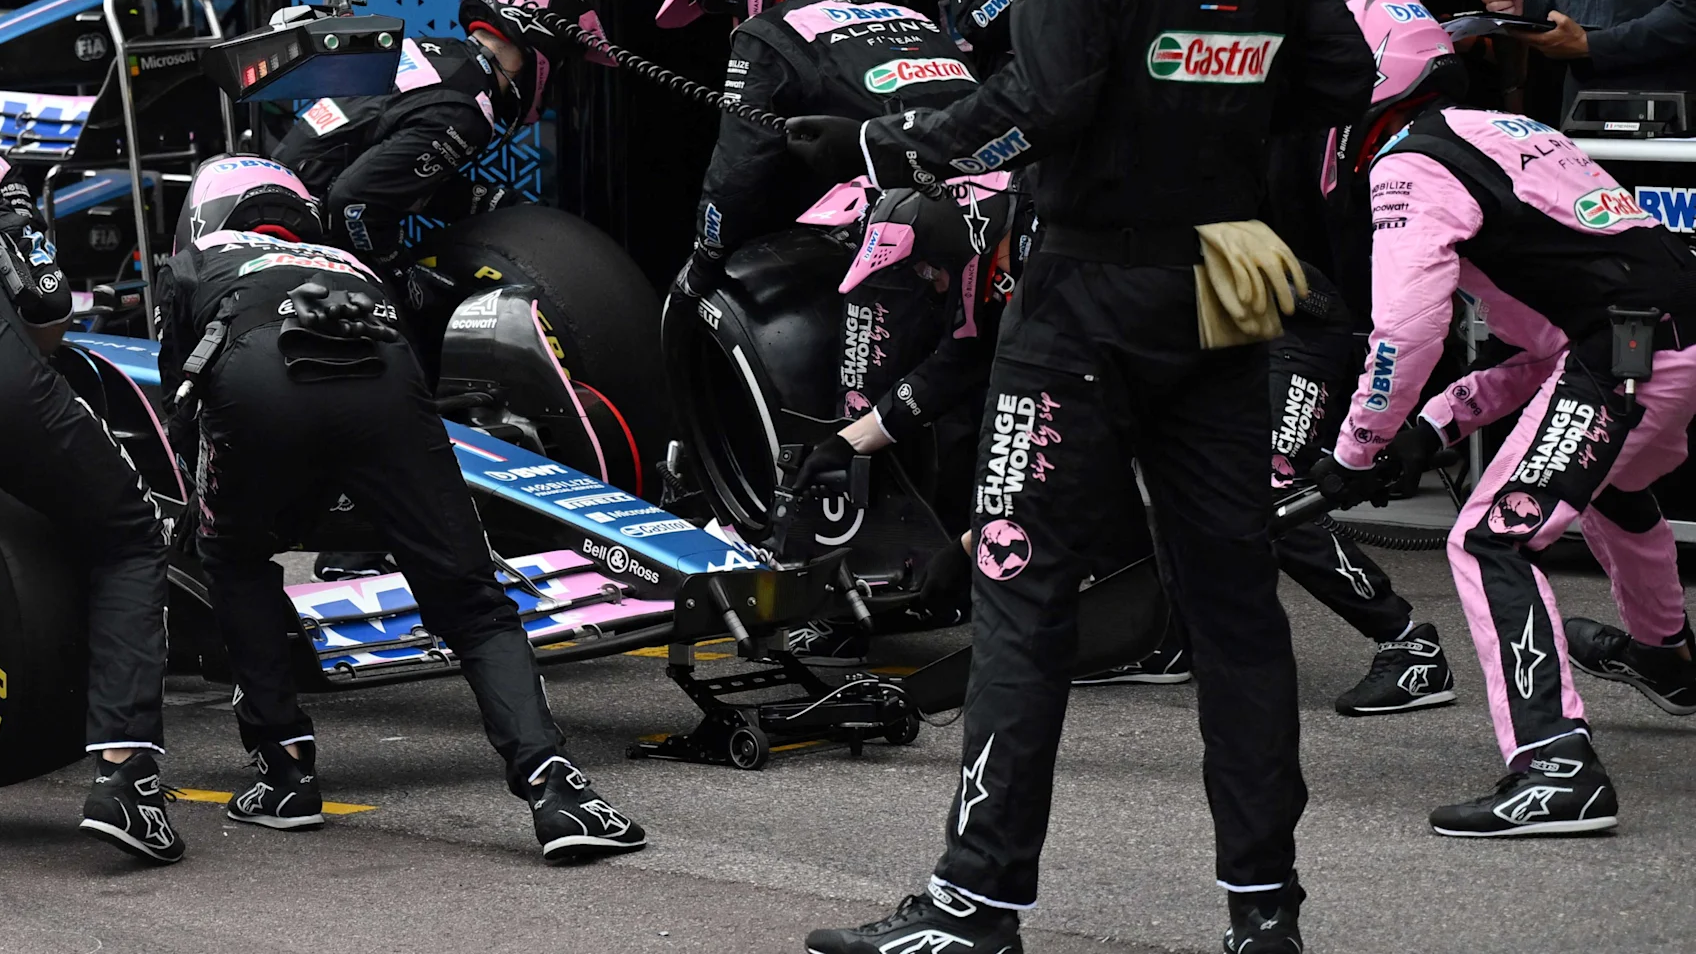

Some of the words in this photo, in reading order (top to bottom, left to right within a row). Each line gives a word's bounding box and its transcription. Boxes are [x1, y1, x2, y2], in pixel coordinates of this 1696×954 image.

[851, 6, 904, 20] BWT
[830, 19, 941, 44] ALPINE
[888, 34, 923, 46] TEAM
[140, 49, 197, 71] Microsoft
[1184, 38, 1270, 77] Castrol
[983, 129, 1030, 169] BWT
[1639, 189, 1696, 230] BW
[867, 229, 880, 254] BWT
[451, 317, 498, 331] ecowatt
[856, 306, 874, 376] WORLD
[844, 302, 861, 389] CHANGE
[1373, 341, 1398, 396] BWT
[1040, 391, 1062, 422] sip
[1275, 373, 1309, 456] CHANGE
[1296, 380, 1320, 446] WORLD
[1005, 395, 1037, 495] WORLD
[1029, 425, 1062, 448] by
[1520, 398, 1579, 484] CHANGE
[1538, 466, 1554, 488] THE
[1550, 403, 1596, 473] WORLD
[512, 464, 569, 480] BWT
[983, 393, 1018, 516] CHANGE
[1032, 450, 1056, 482] sip
[554, 492, 637, 511] PIRELLI
[608, 506, 666, 520] Microsoft
[641, 520, 689, 536] Castrol
[582, 537, 608, 561] Bell
[628, 558, 661, 585] Ross
